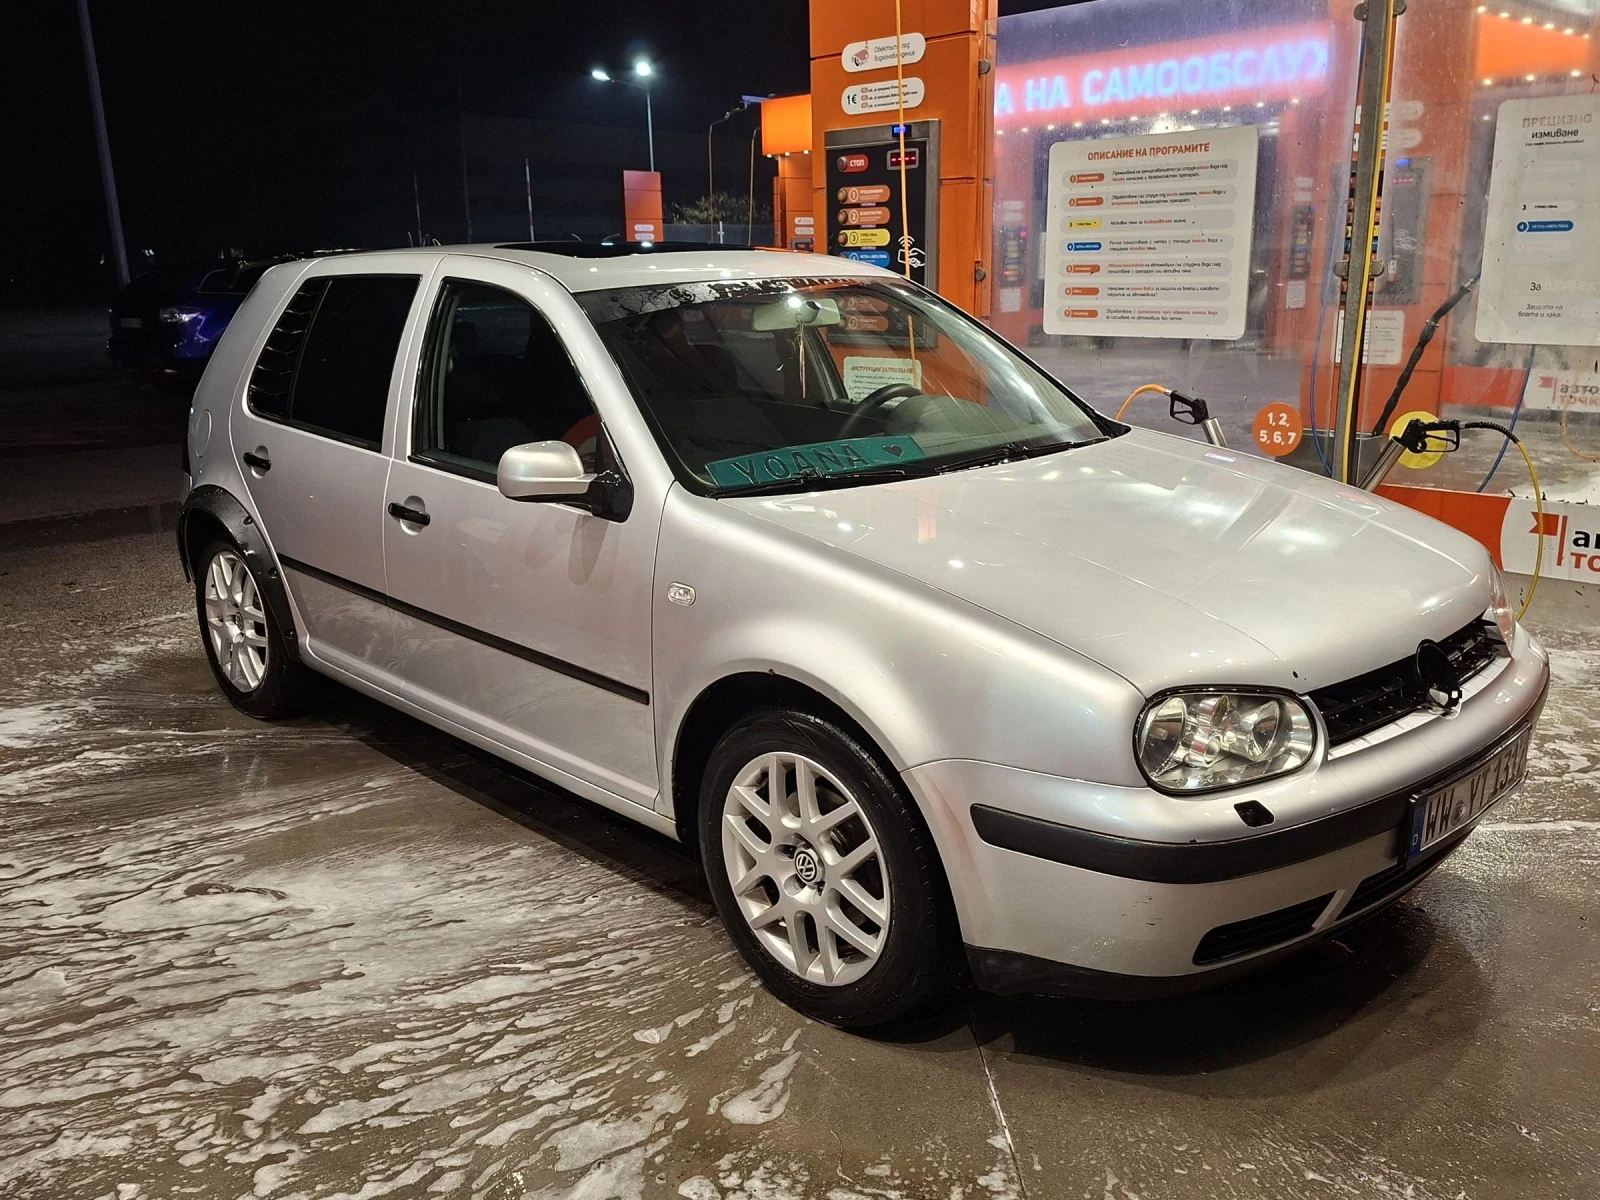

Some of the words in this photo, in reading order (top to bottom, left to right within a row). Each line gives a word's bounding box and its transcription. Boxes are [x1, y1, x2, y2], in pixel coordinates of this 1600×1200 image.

[1026, 76, 1070, 112] НА
[1522, 113, 1592, 128] ПРЕЦИЗНО
[1532, 128, 1579, 138] измиване
[1087, 148, 1134, 161] ОПИСАНИЕ
[1135, 147, 1148, 157] НА
[1149, 143, 1210, 156] ПРОГРАМИТЕ
[1530, 282, 1542, 291] За
[1268, 412, 1276, 426] 1,
[1278, 412, 1290, 428] 2,
[1260, 430, 1270, 444] 5,
[1273, 430, 1284, 446] 6,
[1288, 432, 1296, 444] 7
[731, 443, 870, 486] YOANA
[1424, 788, 1455, 843] WW
[1412, 833, 1418, 846] D
